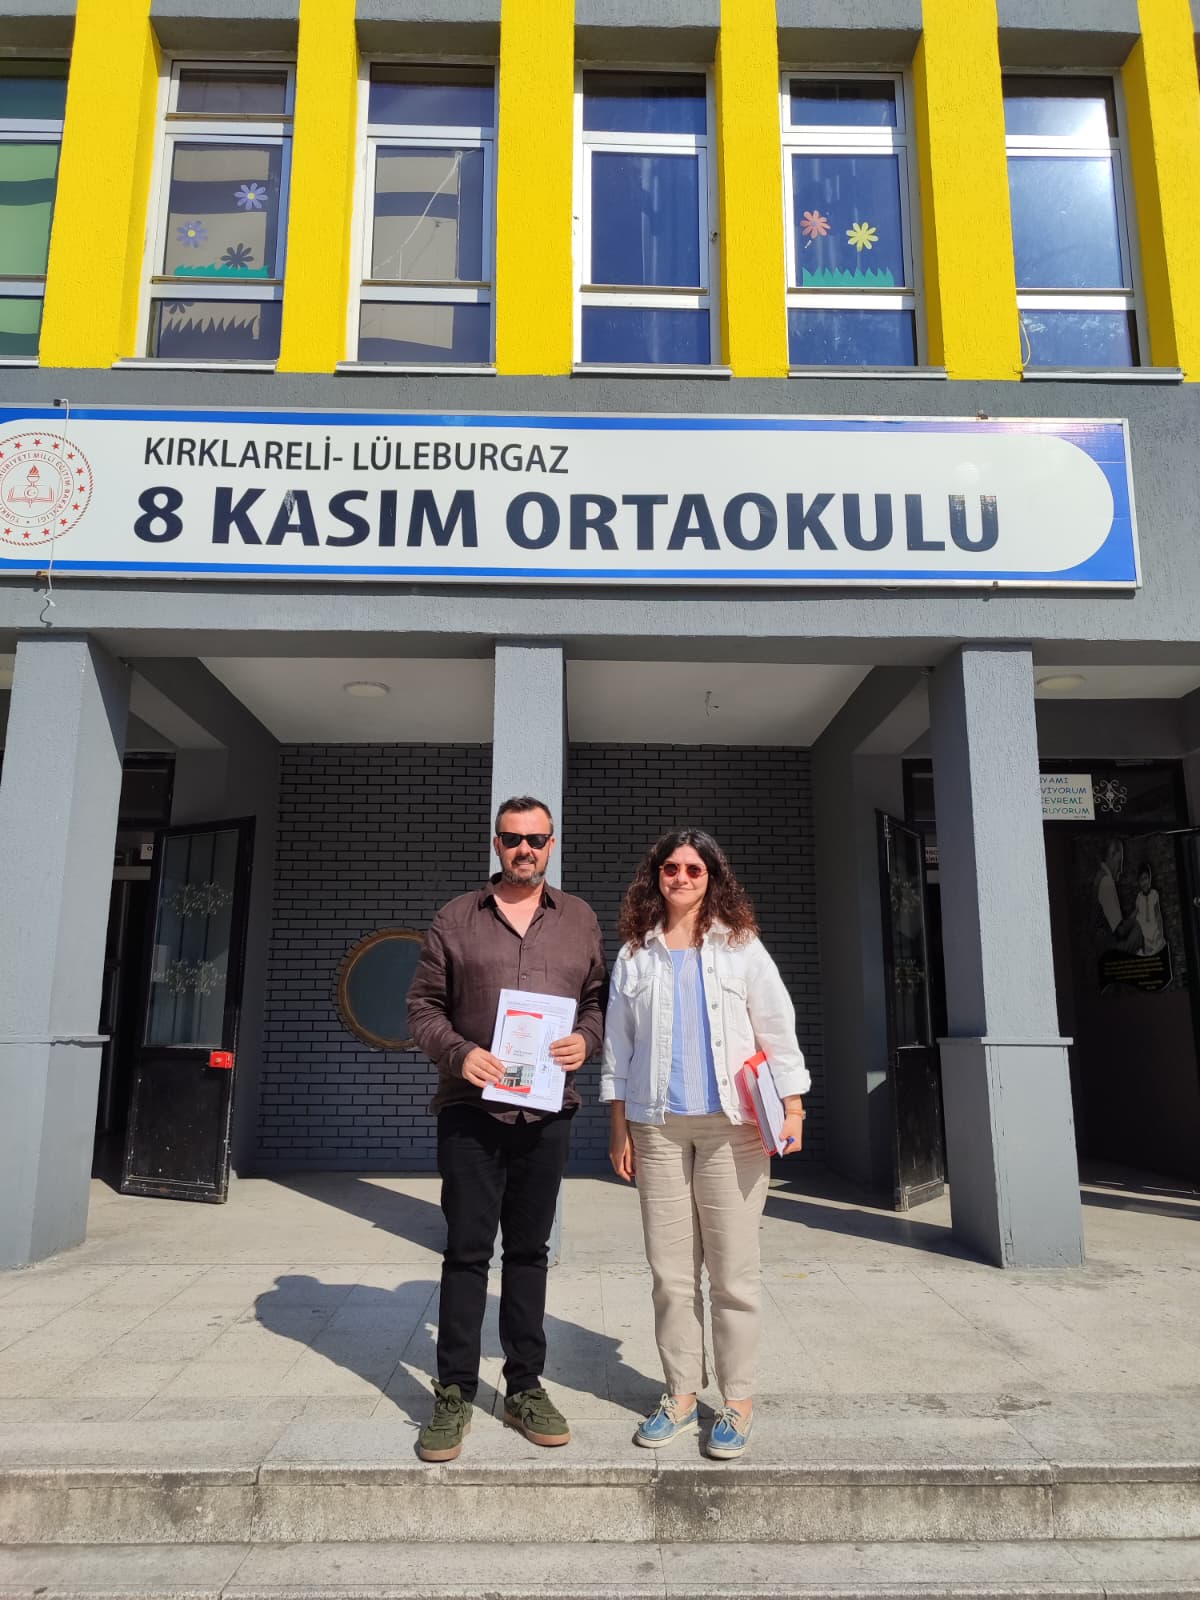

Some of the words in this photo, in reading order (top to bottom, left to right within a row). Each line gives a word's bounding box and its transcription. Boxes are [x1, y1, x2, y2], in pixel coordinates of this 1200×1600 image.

[144, 435, 343, 471] KIRKLARELİ-
[353, 436, 570, 475] LÜLEBURGAZ
[134, 486, 184, 544] 8
[211, 487, 479, 548] KASIM
[505, 491, 999, 553] ORTAOKULU
[1042, 807, 1090, 815] RUYORUM
